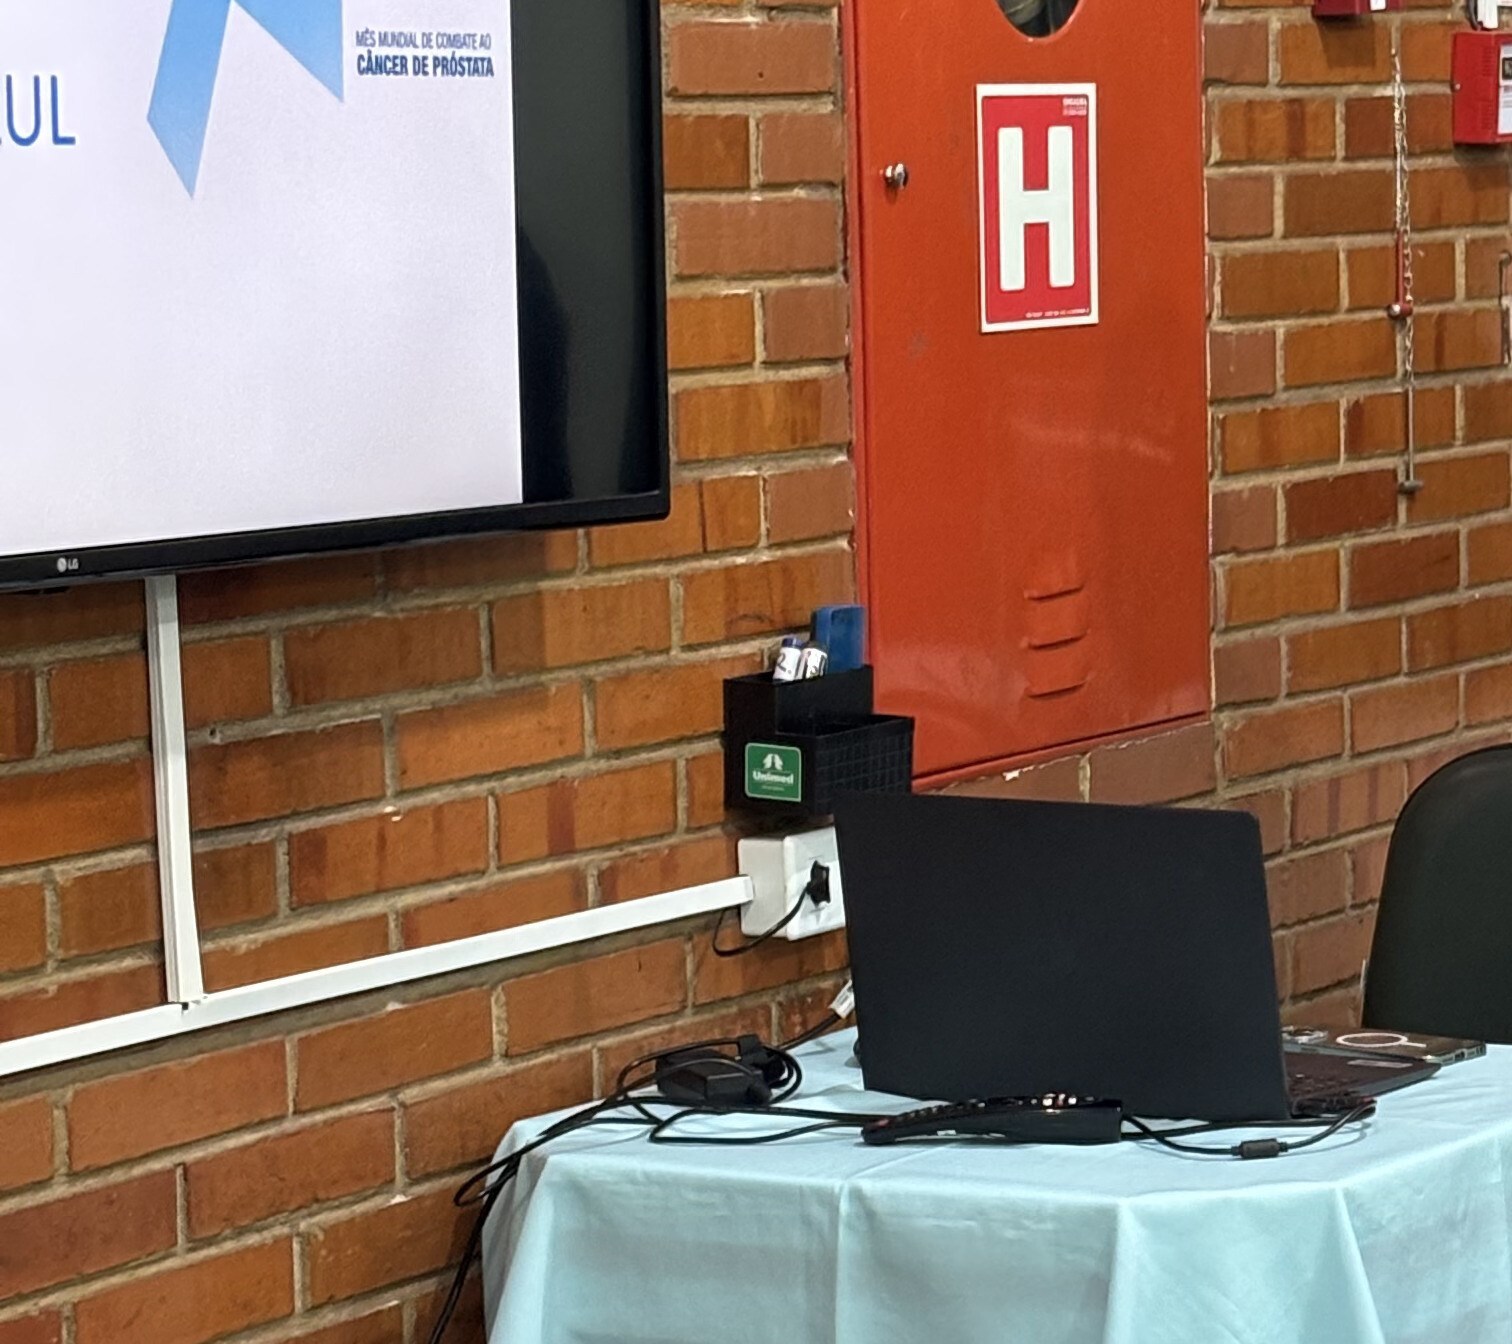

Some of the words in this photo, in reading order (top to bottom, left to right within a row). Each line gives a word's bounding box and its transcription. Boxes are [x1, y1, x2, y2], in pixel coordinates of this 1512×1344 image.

[355, 27, 376, 48] MÊS
[378, 30, 419, 49] MUNDIAL
[421, 31, 434, 49] DE
[435, 31, 478, 50] COMBATE
[479, 32, 492, 50] AO
[357, 49, 409, 76] CÂNCER
[412, 55, 430, 76] DE
[432, 51, 495, 77] PRÓSTATA
[0, 74, 76, 147] UL
[997, 125, 1076, 292] H
[752, 770, 794, 785] Unimed
